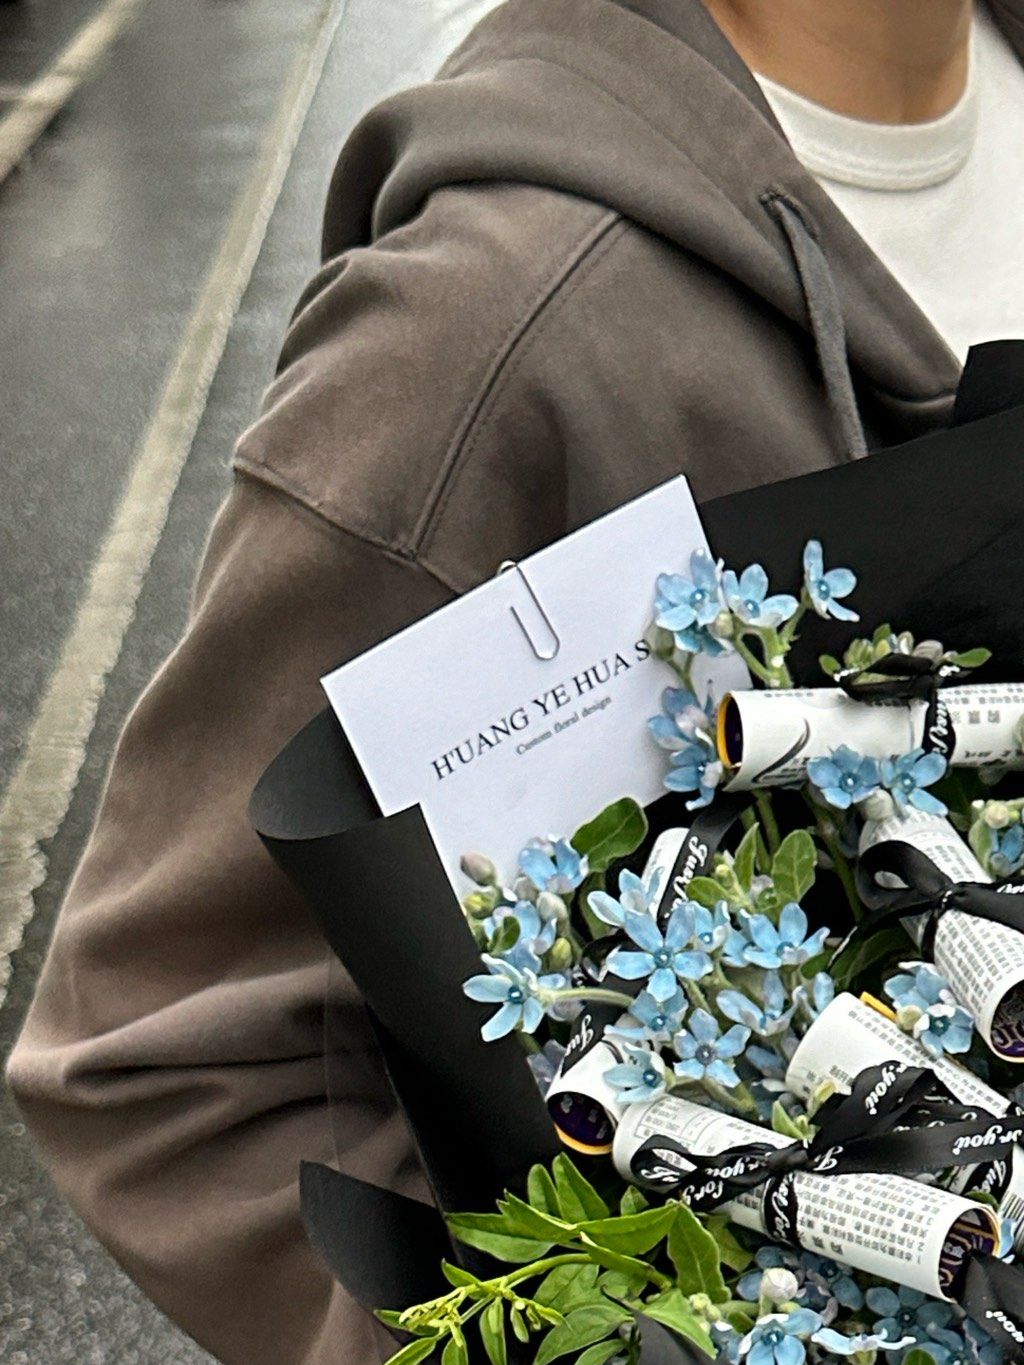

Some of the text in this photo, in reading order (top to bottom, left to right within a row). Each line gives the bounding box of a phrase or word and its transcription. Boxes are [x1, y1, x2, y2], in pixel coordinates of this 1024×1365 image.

[533, 685, 570, 715] YE
[573, 654, 630, 695] HUA
[953, 1125, 1004, 1155] you
